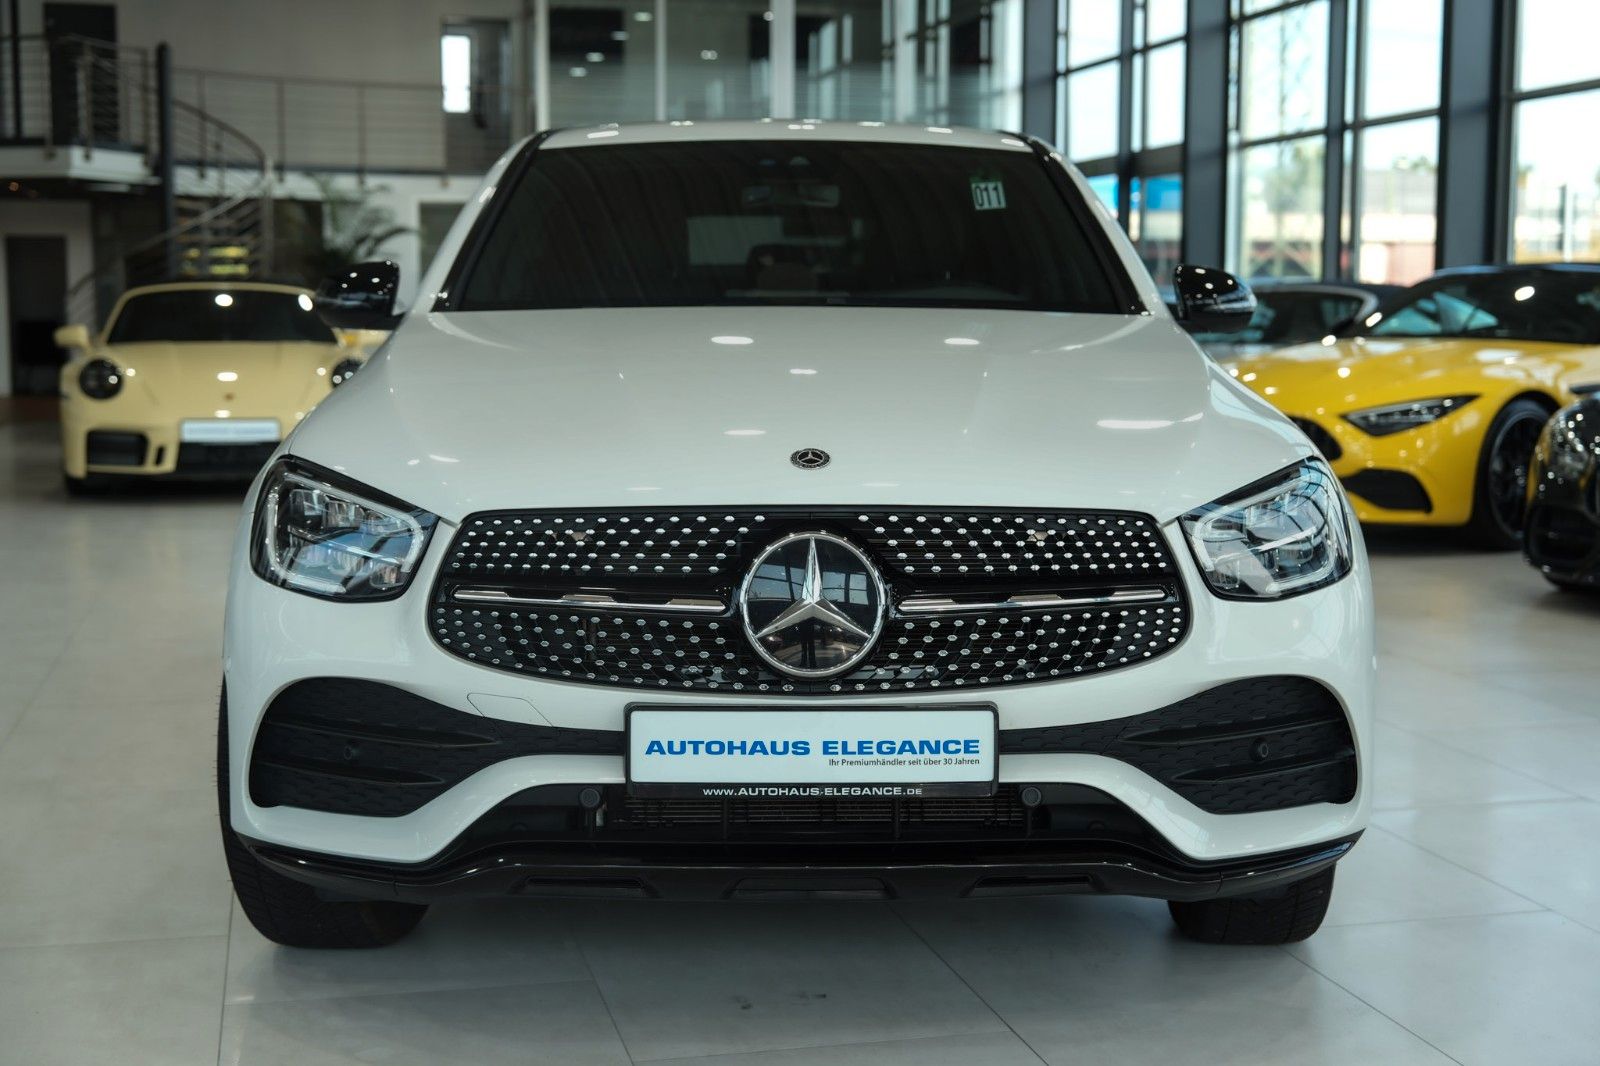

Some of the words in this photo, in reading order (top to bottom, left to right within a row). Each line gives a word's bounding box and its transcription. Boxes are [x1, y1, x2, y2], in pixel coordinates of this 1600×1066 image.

[975, 185, 1001, 207] 011
[645, 740, 810, 756] AUTOHAUS
[822, 739, 980, 755] ELEGANCE
[828, 758, 839, 766] Ihr
[841, 758, 906, 766] Premiumhändler
[908, 758, 922, 766] seit
[923, 758, 942, 766] über
